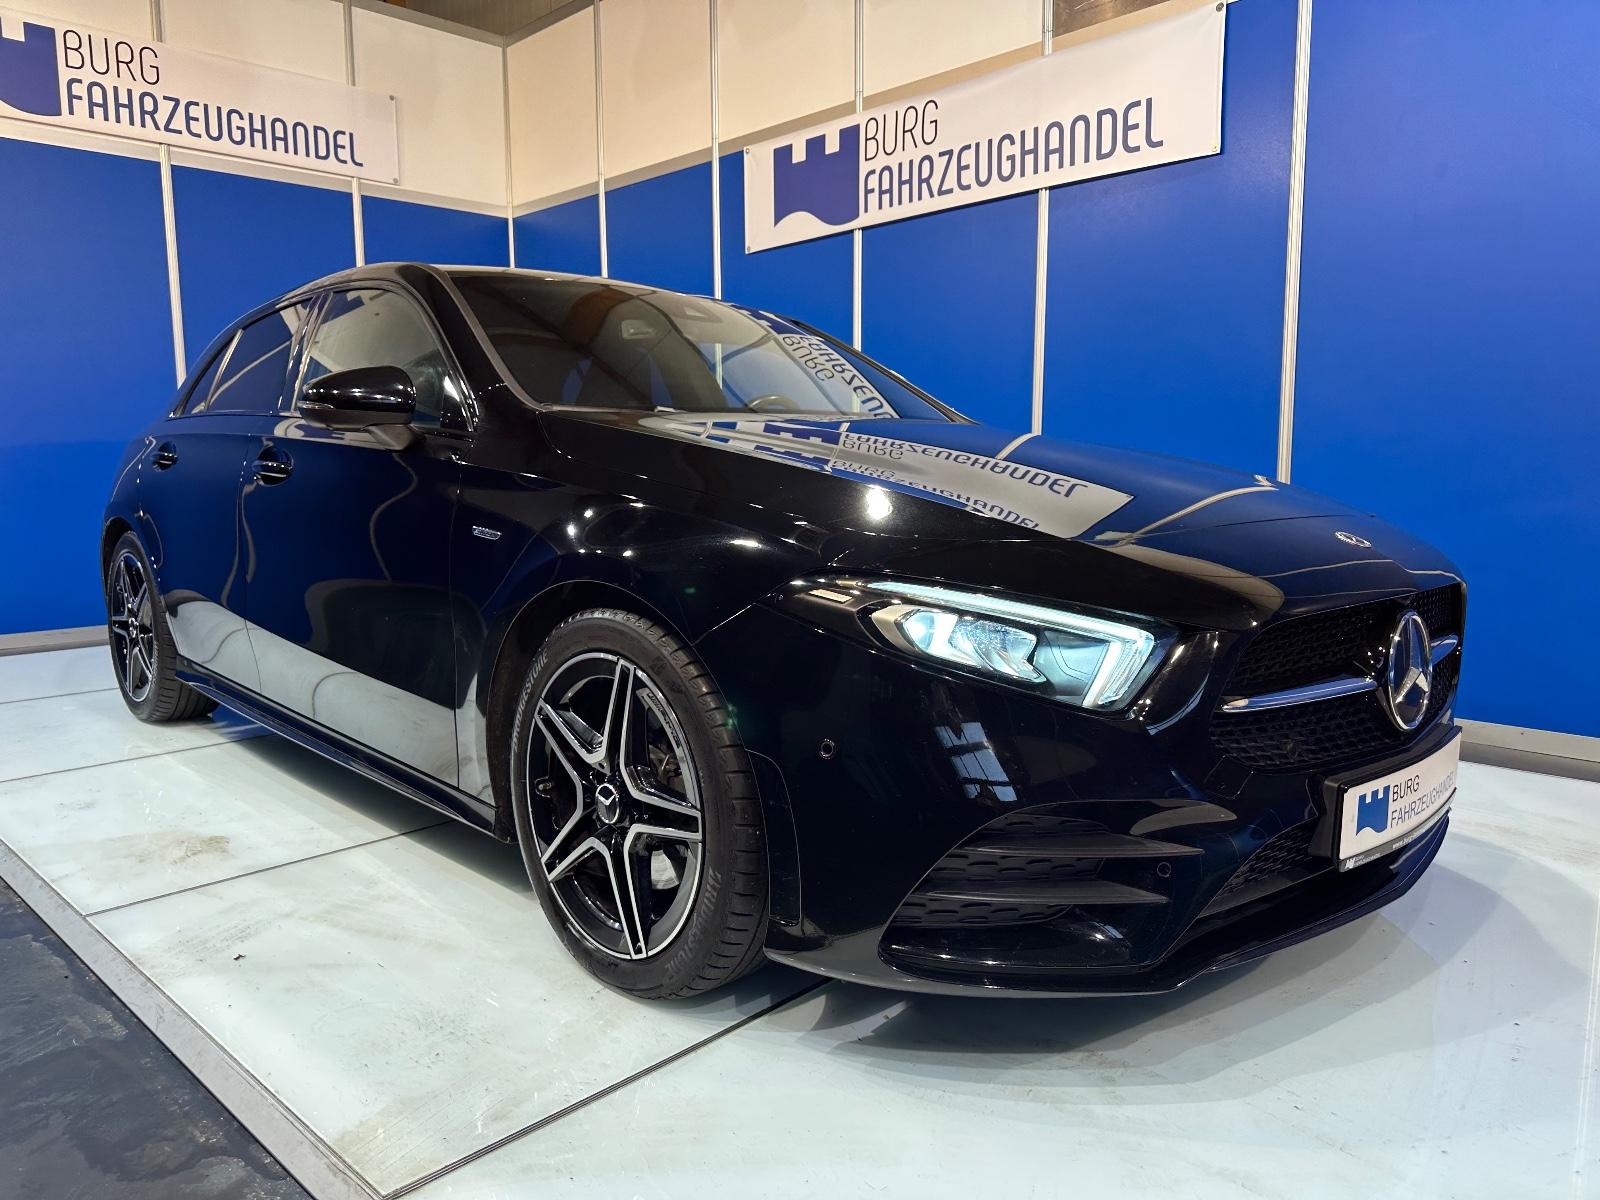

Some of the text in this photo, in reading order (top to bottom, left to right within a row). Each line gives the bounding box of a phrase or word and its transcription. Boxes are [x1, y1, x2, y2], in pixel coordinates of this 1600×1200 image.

[63, 29, 160, 86] BURG
[66, 78, 364, 167] FAHRZEUGHANDEL
[865, 99, 939, 162] BURG
[864, 97, 1164, 214] FAHRZEUGHANDEL
[1392, 774, 1420, 803] BURG
